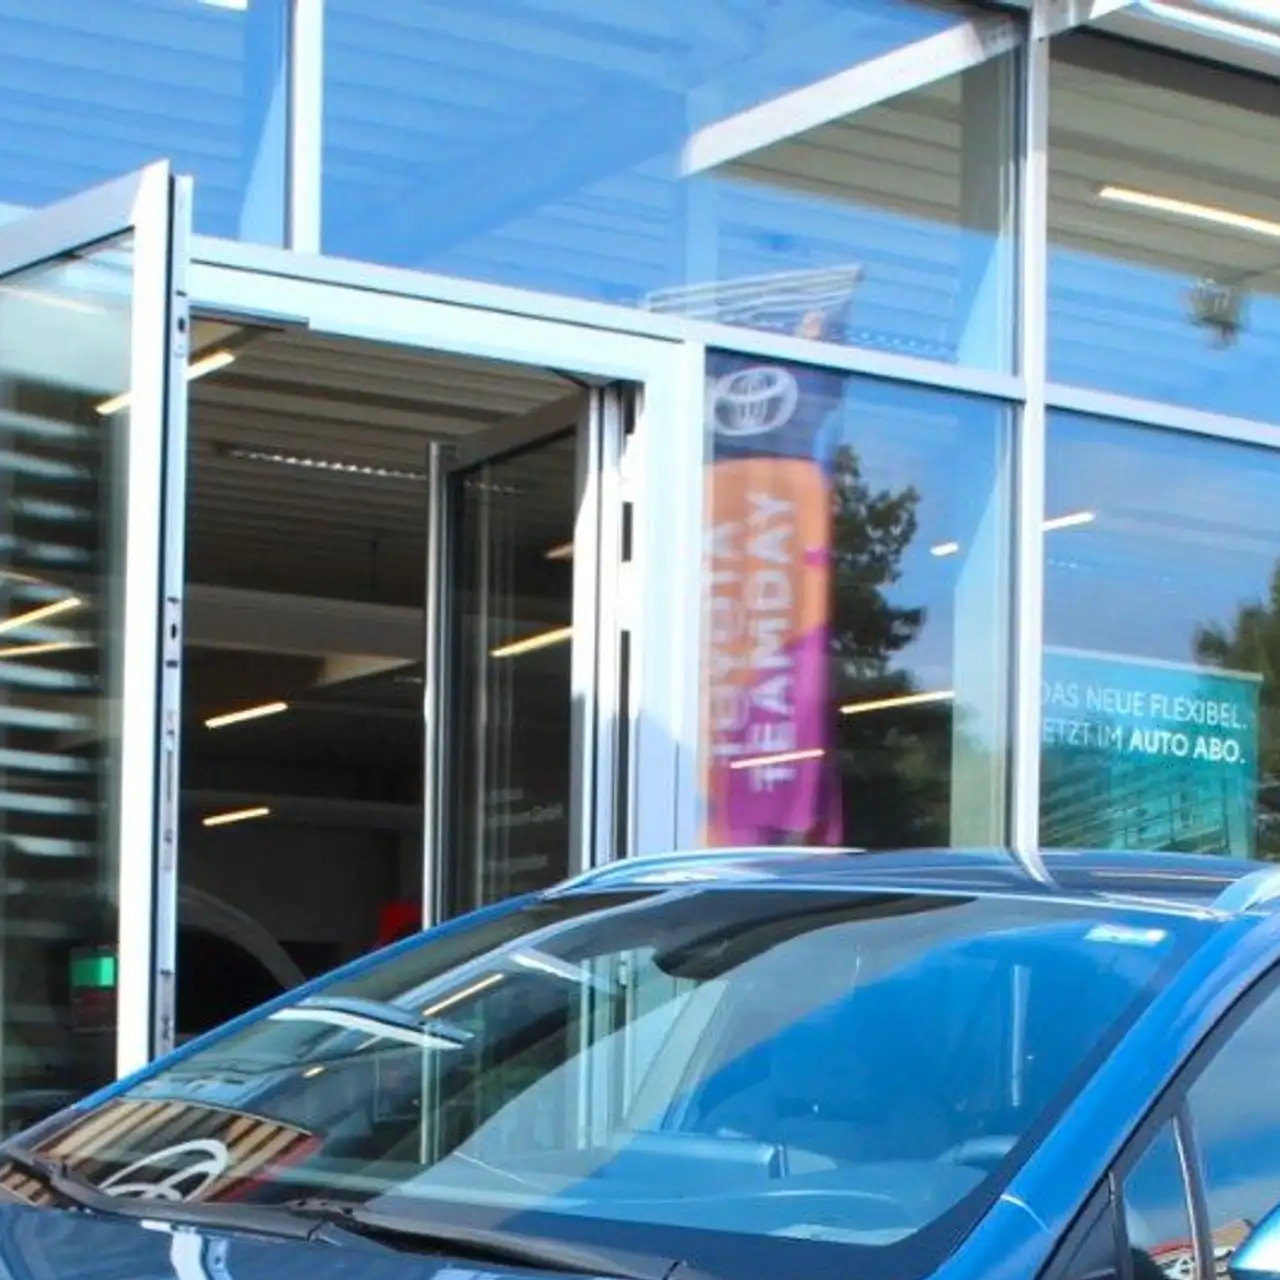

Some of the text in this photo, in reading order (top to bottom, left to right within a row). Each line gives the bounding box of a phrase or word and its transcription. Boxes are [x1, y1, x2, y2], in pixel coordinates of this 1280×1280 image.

[744, 491, 797, 792] TEAMDAY
[1086, 684, 1144, 717] NEUE
[1150, 693, 1247, 729] FLEXIBEL.
[1043, 718, 1246, 764] ETZT IM AUTO ABO.
